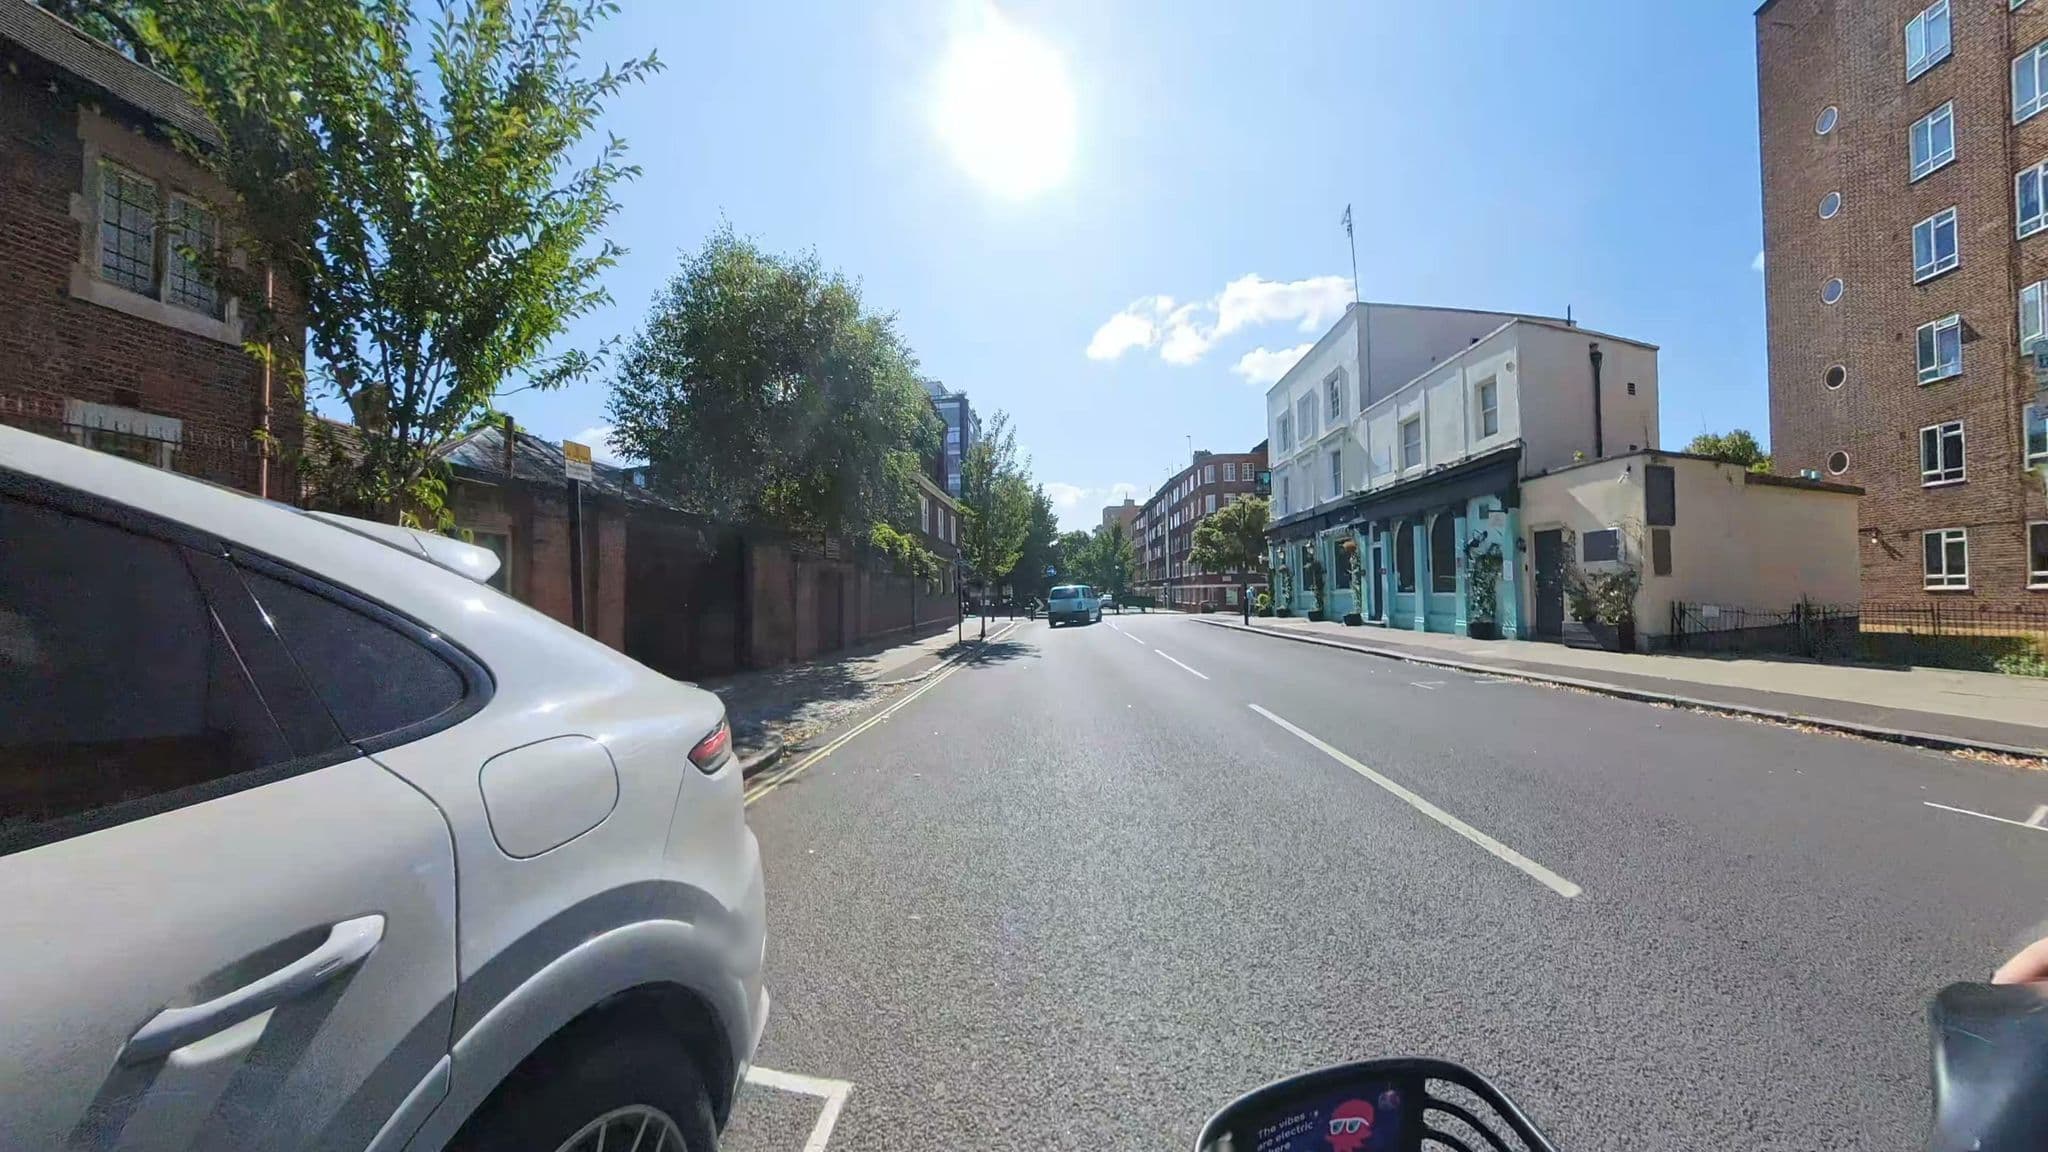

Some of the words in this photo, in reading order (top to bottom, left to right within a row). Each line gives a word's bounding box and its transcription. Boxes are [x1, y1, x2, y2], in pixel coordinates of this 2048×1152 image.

[1257, 1139, 1273, 1152] are
[1275, 1121, 1313, 1142] electric
[1258, 1125, 1276, 1138] The
[1279, 1113, 1306, 1128] vibes
